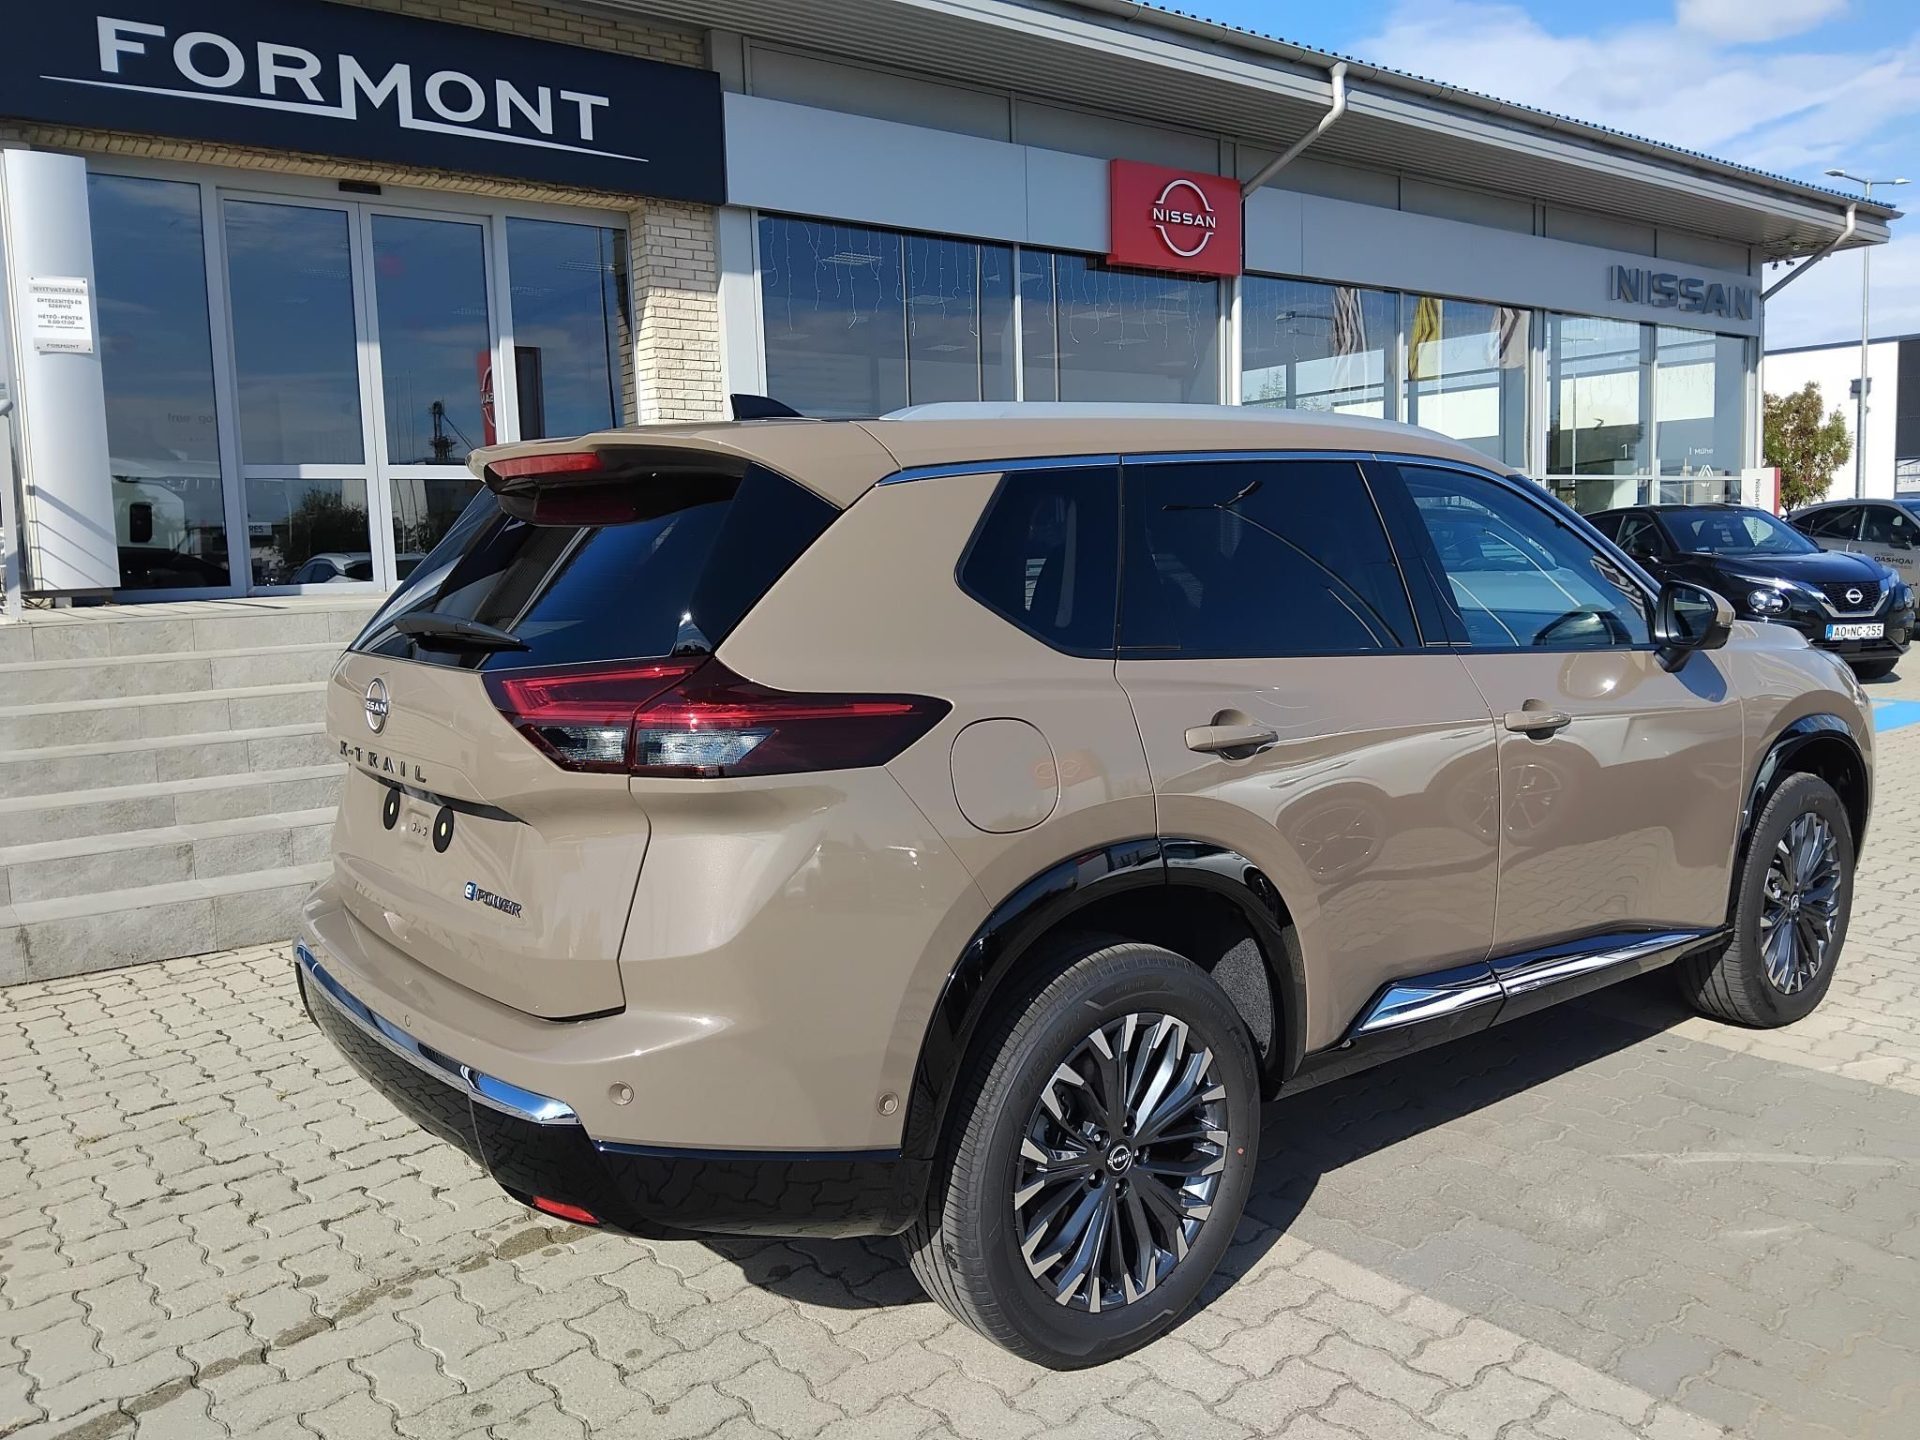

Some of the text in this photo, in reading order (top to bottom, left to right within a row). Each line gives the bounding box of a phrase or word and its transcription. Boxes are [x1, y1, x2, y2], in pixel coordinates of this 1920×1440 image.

[97, 15, 610, 141] FORMONT
[1153, 207, 1215, 228] NISSAN
[1611, 265, 1752, 320] NISSAN
